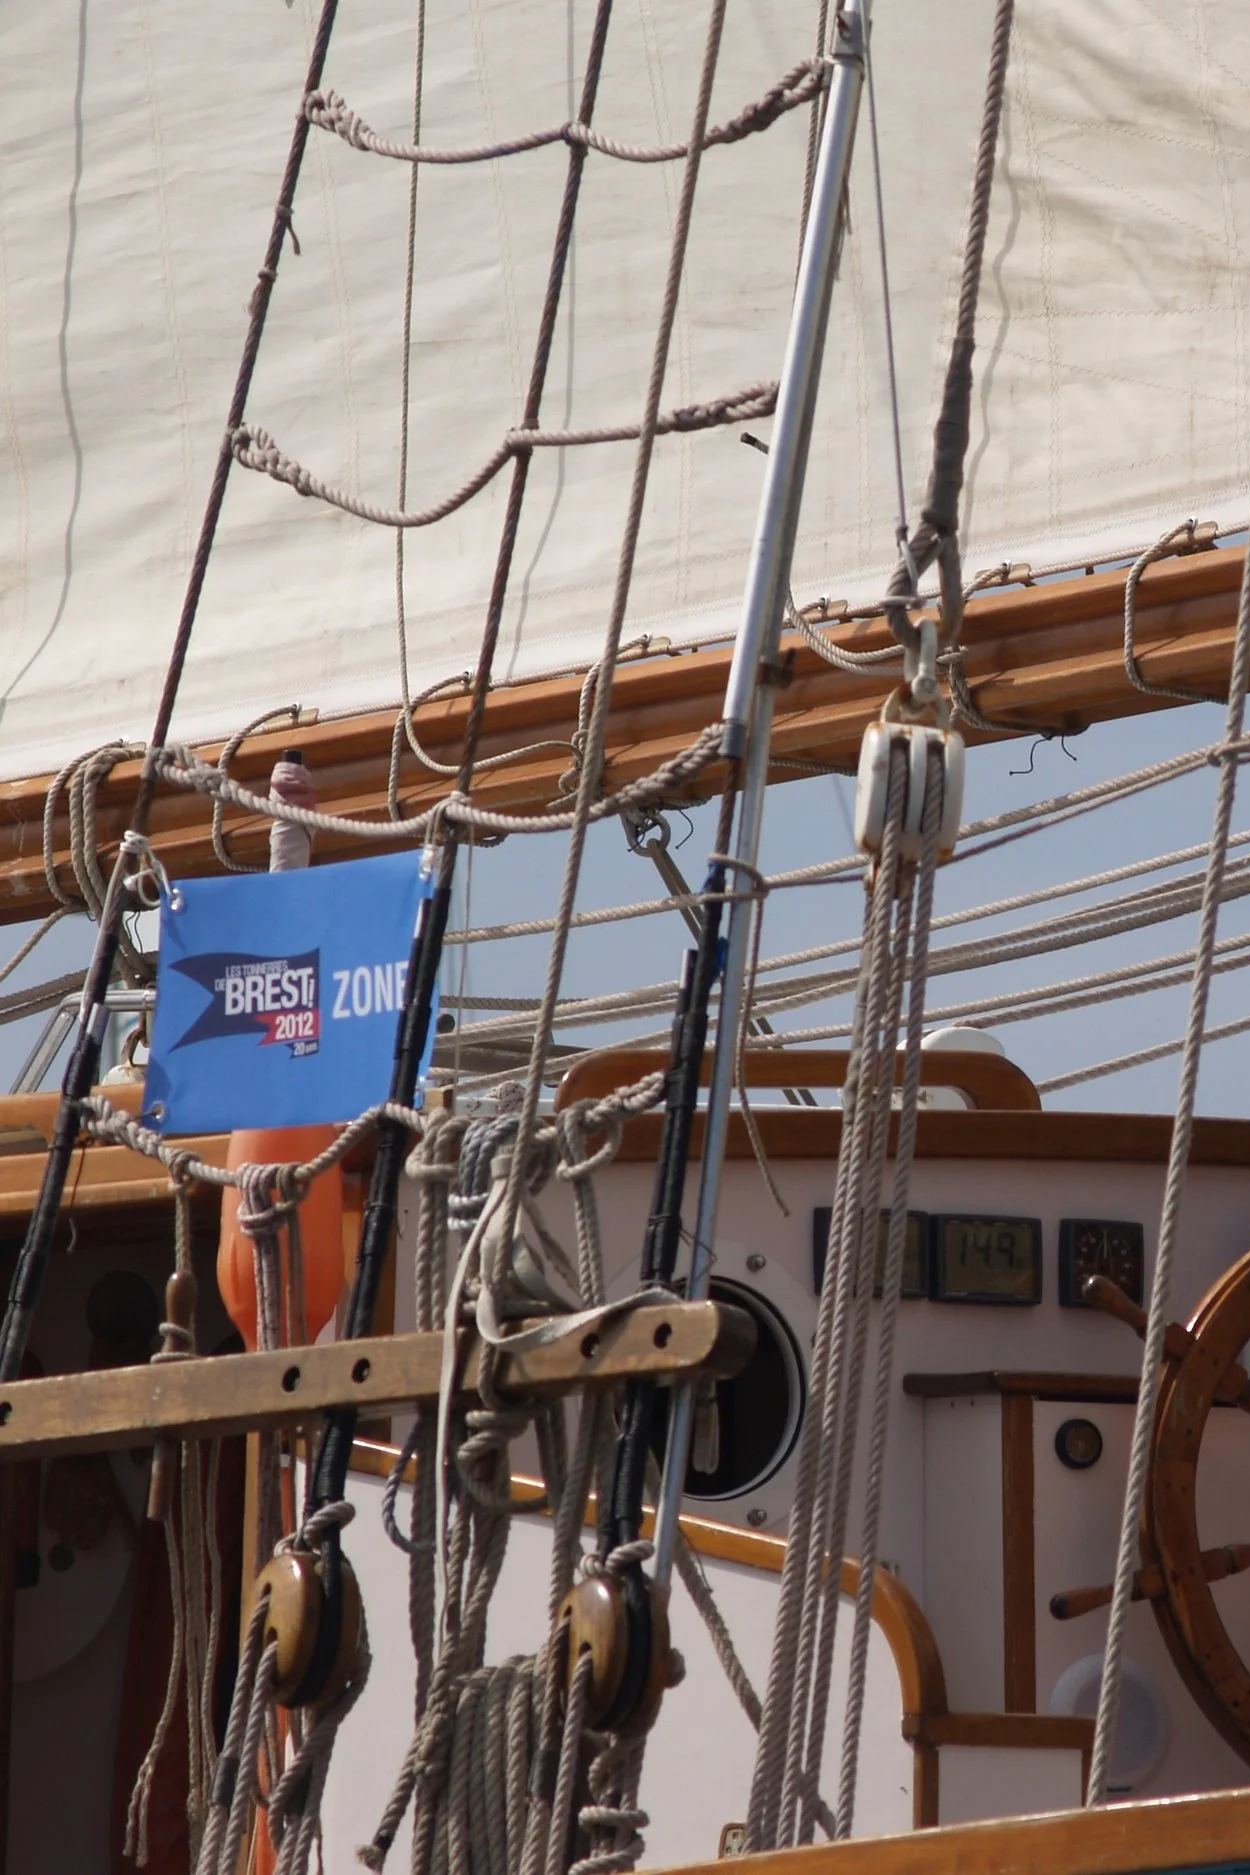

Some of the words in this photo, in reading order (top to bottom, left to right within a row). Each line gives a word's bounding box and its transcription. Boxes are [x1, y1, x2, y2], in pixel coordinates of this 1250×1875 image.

[225, 964, 242, 978] LES
[214, 978, 226, 992] DE
[225, 968, 314, 1015] BREST!
[275, 1011, 314, 1040] 2012
[293, 1042, 305, 1056] 20
